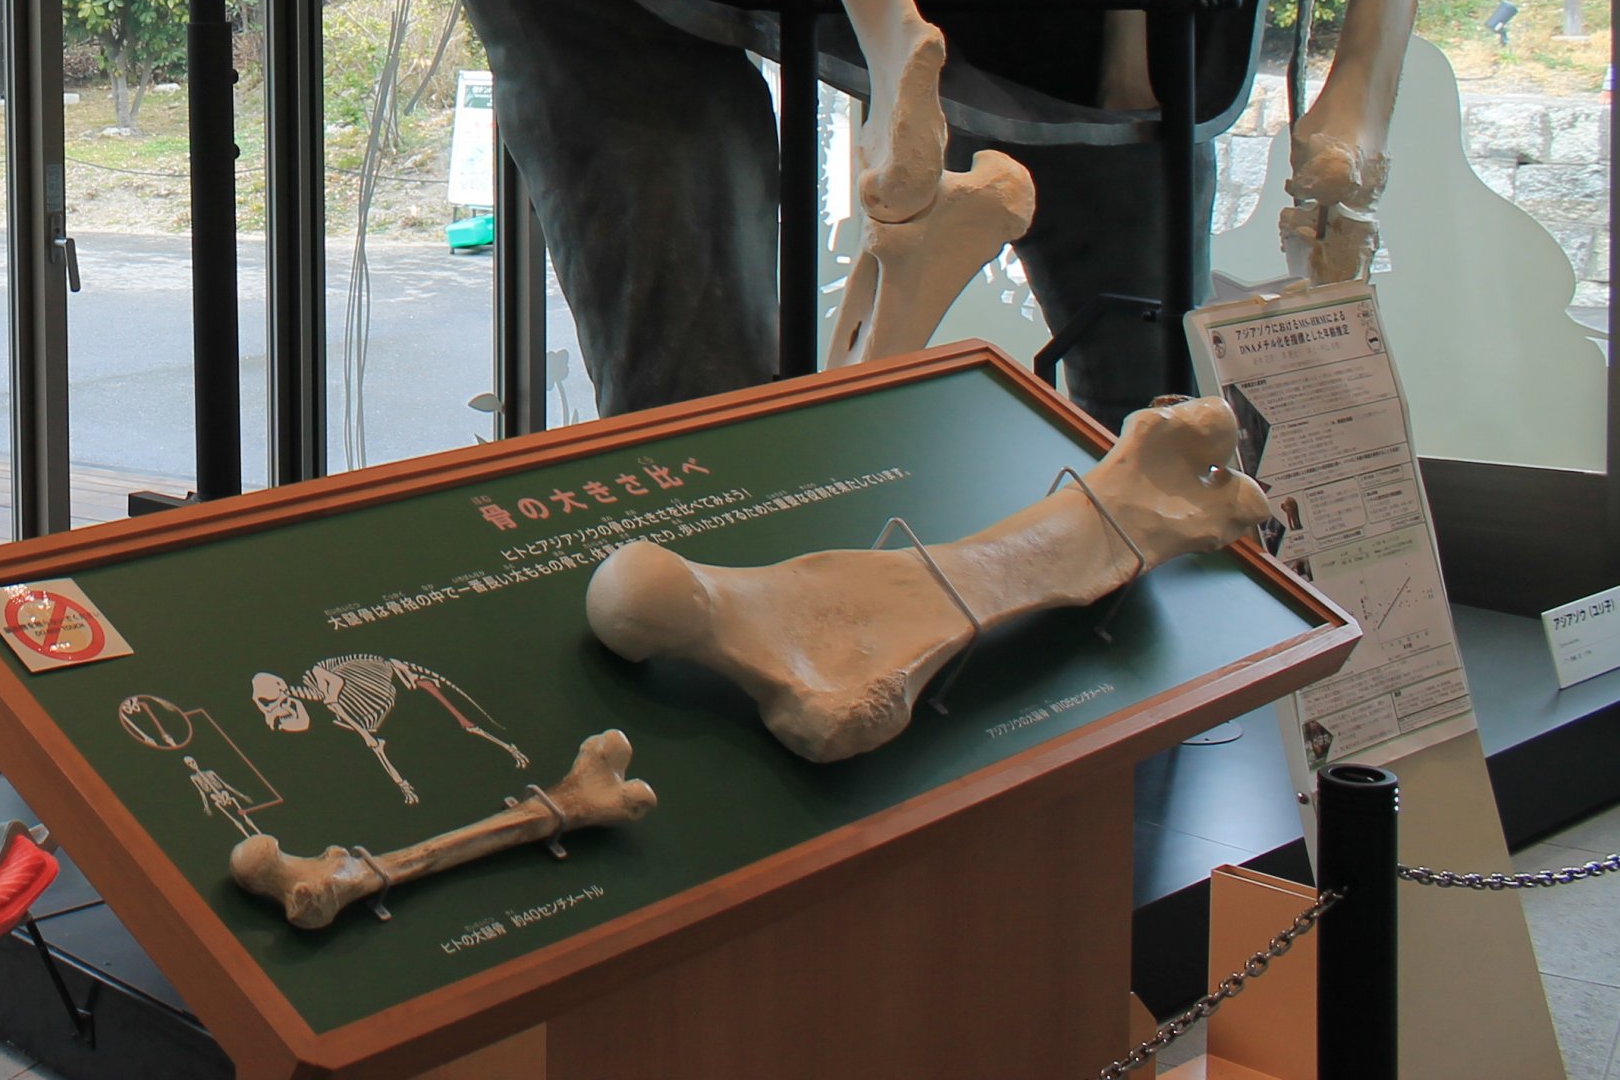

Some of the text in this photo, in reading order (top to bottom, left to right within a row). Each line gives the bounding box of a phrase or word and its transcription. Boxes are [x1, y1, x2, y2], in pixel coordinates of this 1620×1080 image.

[479, 457, 711, 531] 骨の大きさ比べ
